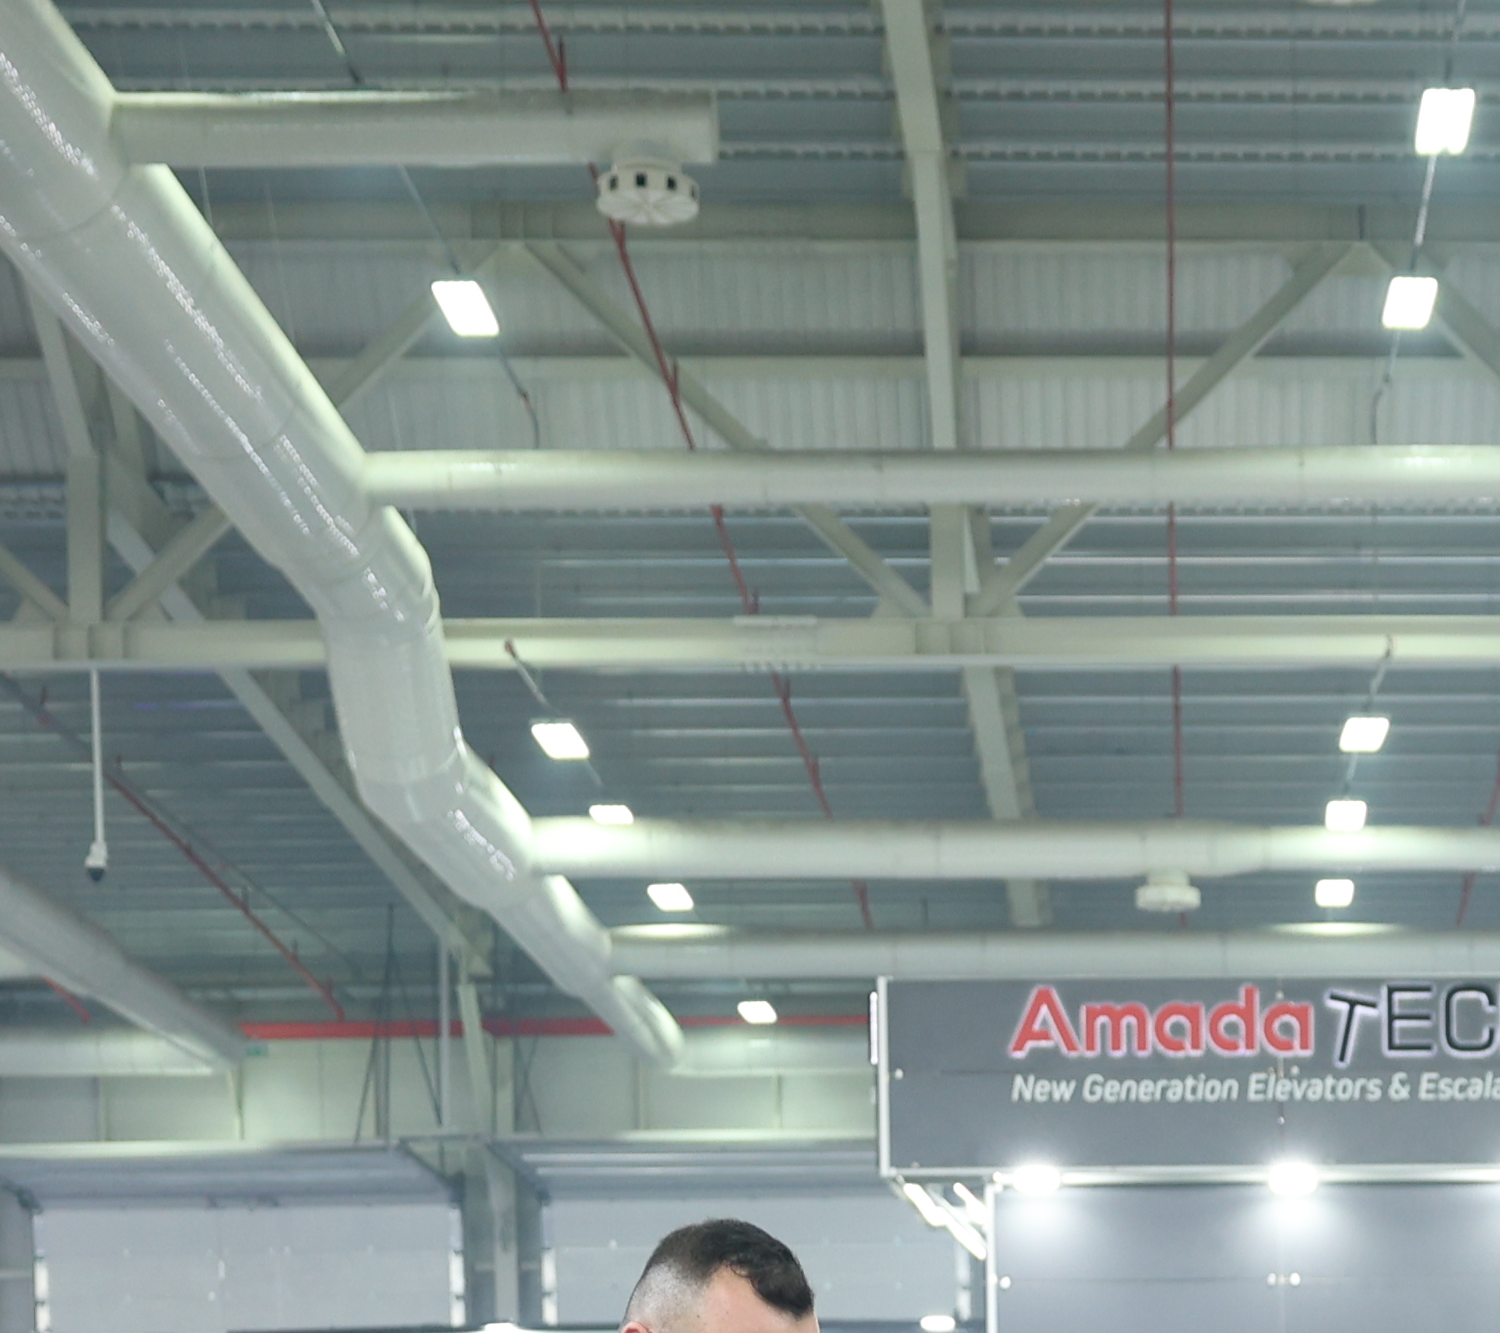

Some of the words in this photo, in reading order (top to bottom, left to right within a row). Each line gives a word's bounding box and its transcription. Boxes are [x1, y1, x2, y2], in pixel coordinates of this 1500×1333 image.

[1011, 1073, 1077, 1102] New
[1082, 1073, 1239, 1102] Generation
[1248, 1072, 1382, 1101] Elevators
[1388, 1071, 1411, 1100] &
